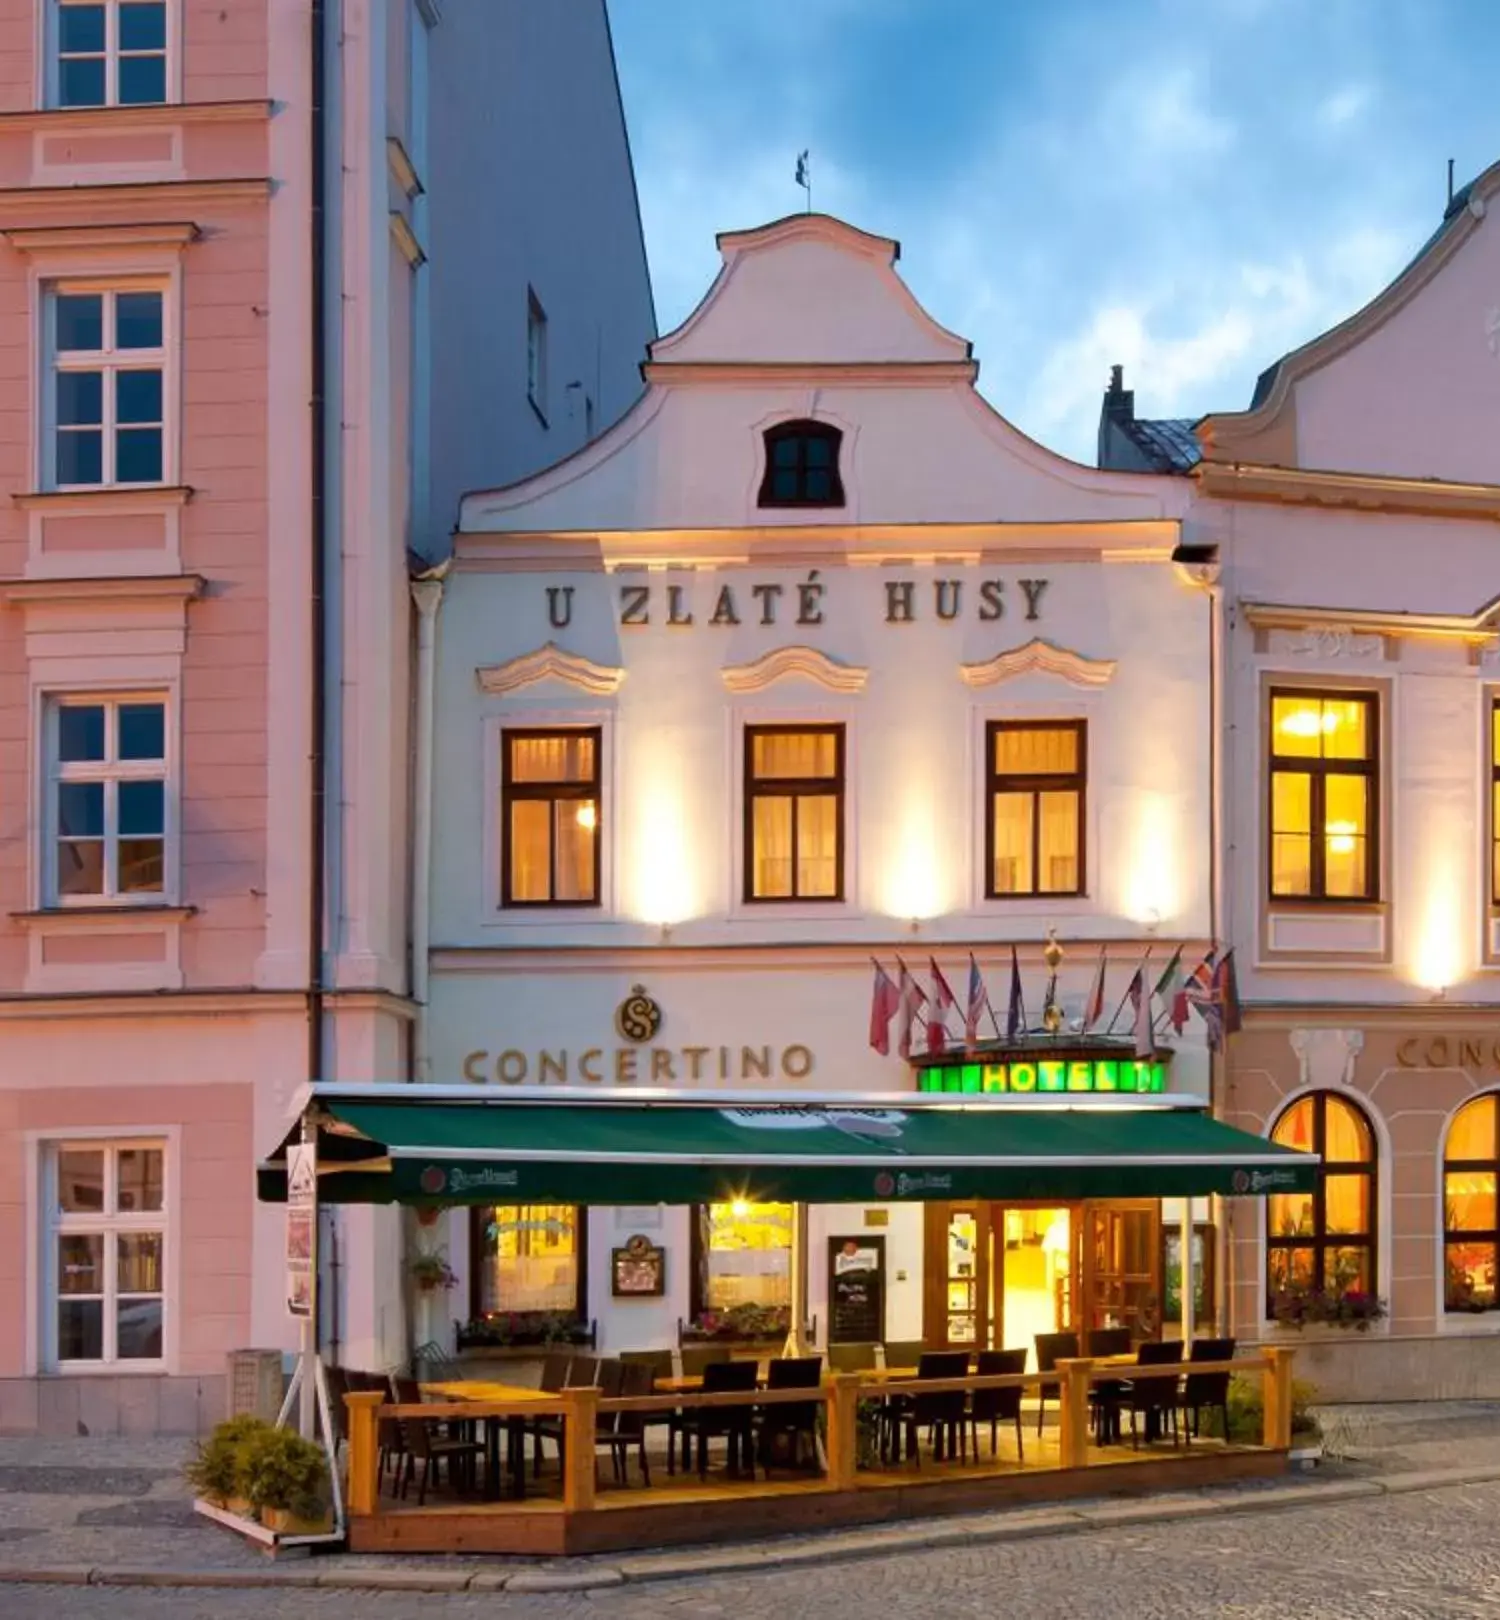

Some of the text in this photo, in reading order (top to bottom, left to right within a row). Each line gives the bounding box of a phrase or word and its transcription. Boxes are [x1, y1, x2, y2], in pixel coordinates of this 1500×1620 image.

[546, 569, 1049, 628] U ZLATÉ HUSY
[464, 1043, 814, 1085] CONCERTINO
[982, 1060, 1116, 1093] HOTEL
